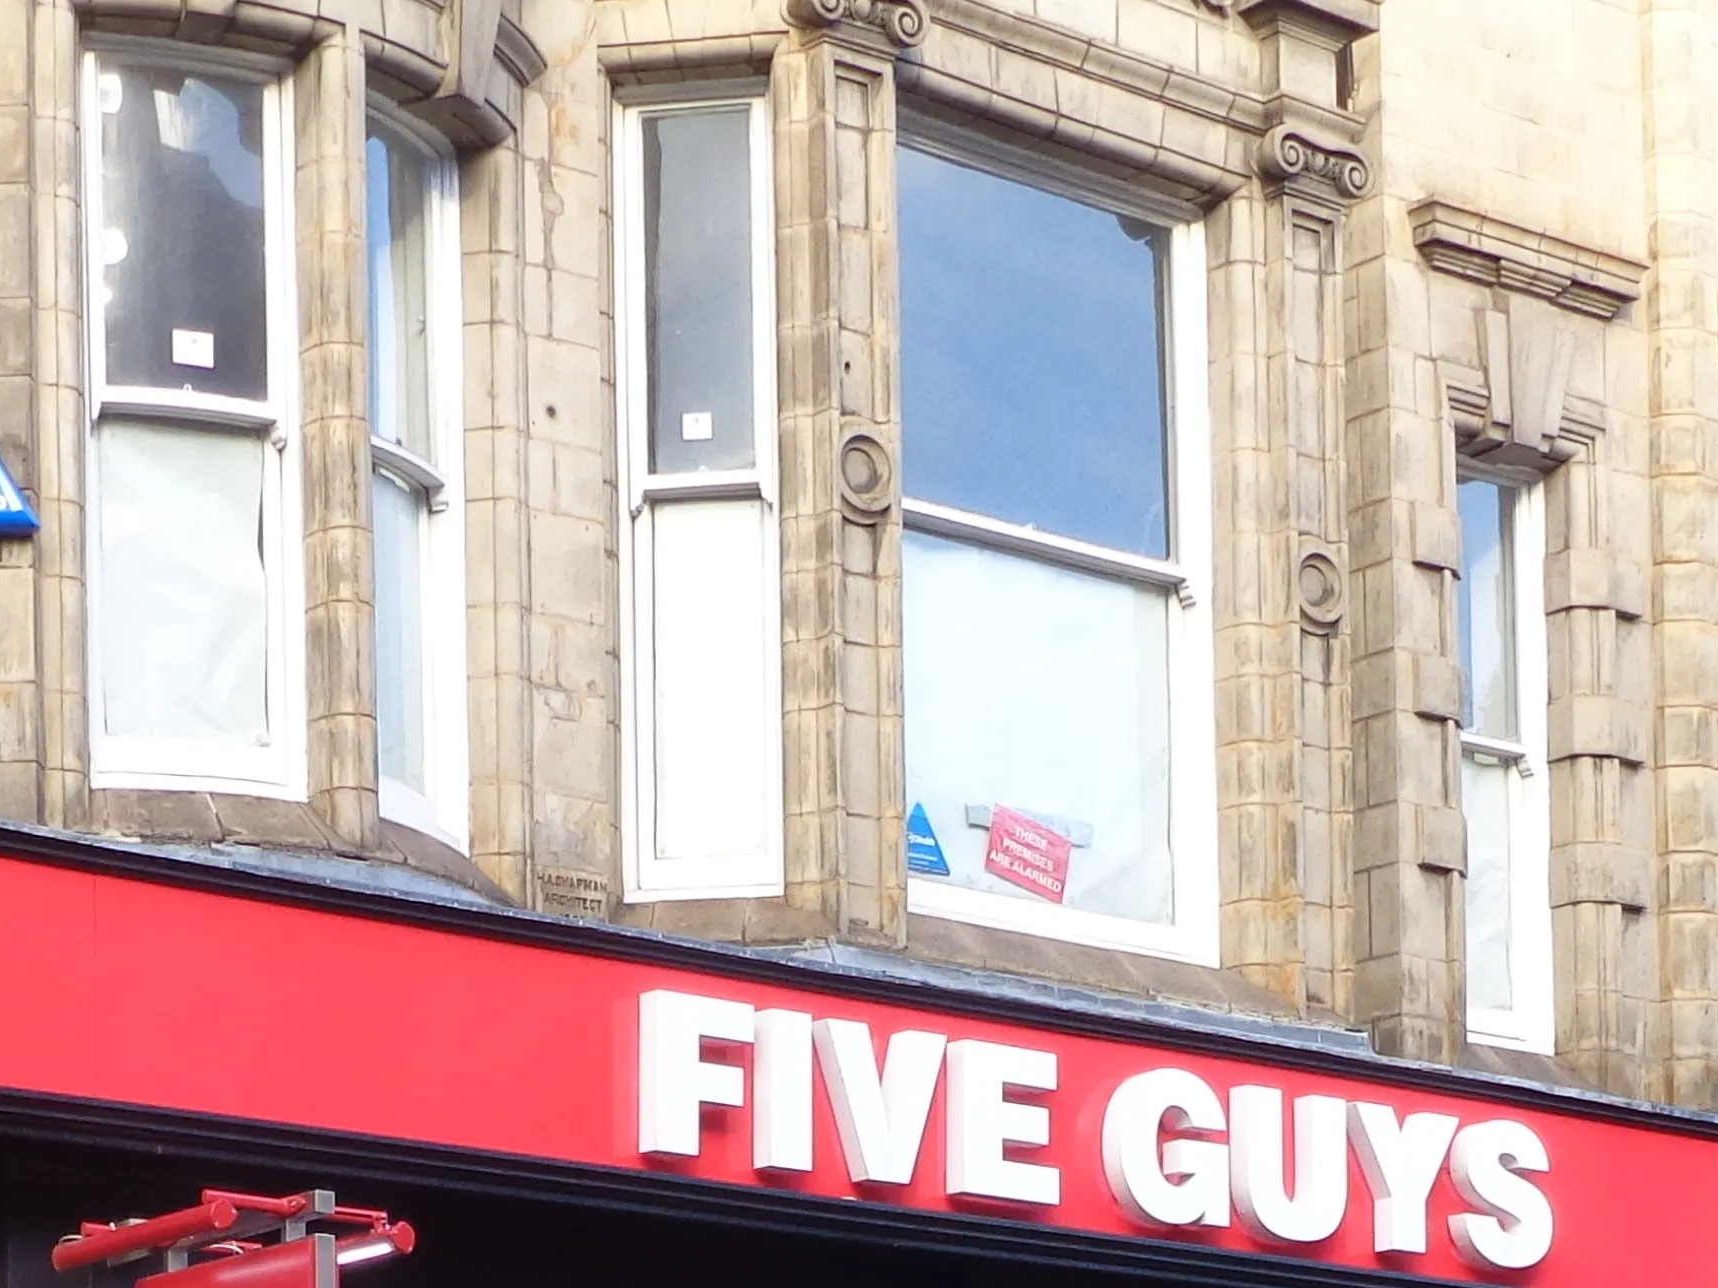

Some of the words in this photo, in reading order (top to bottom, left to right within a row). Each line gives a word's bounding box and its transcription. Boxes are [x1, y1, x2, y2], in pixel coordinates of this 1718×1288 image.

[1003, 837, 1054, 872] PREMISES
[1014, 826, 1048, 851] THESE
[989, 850, 1010, 869] ARE
[1012, 862, 1061, 893] ALARMED
[638, 989, 1060, 1206] FIVE
[1101, 1067, 1554, 1270] GUYS
